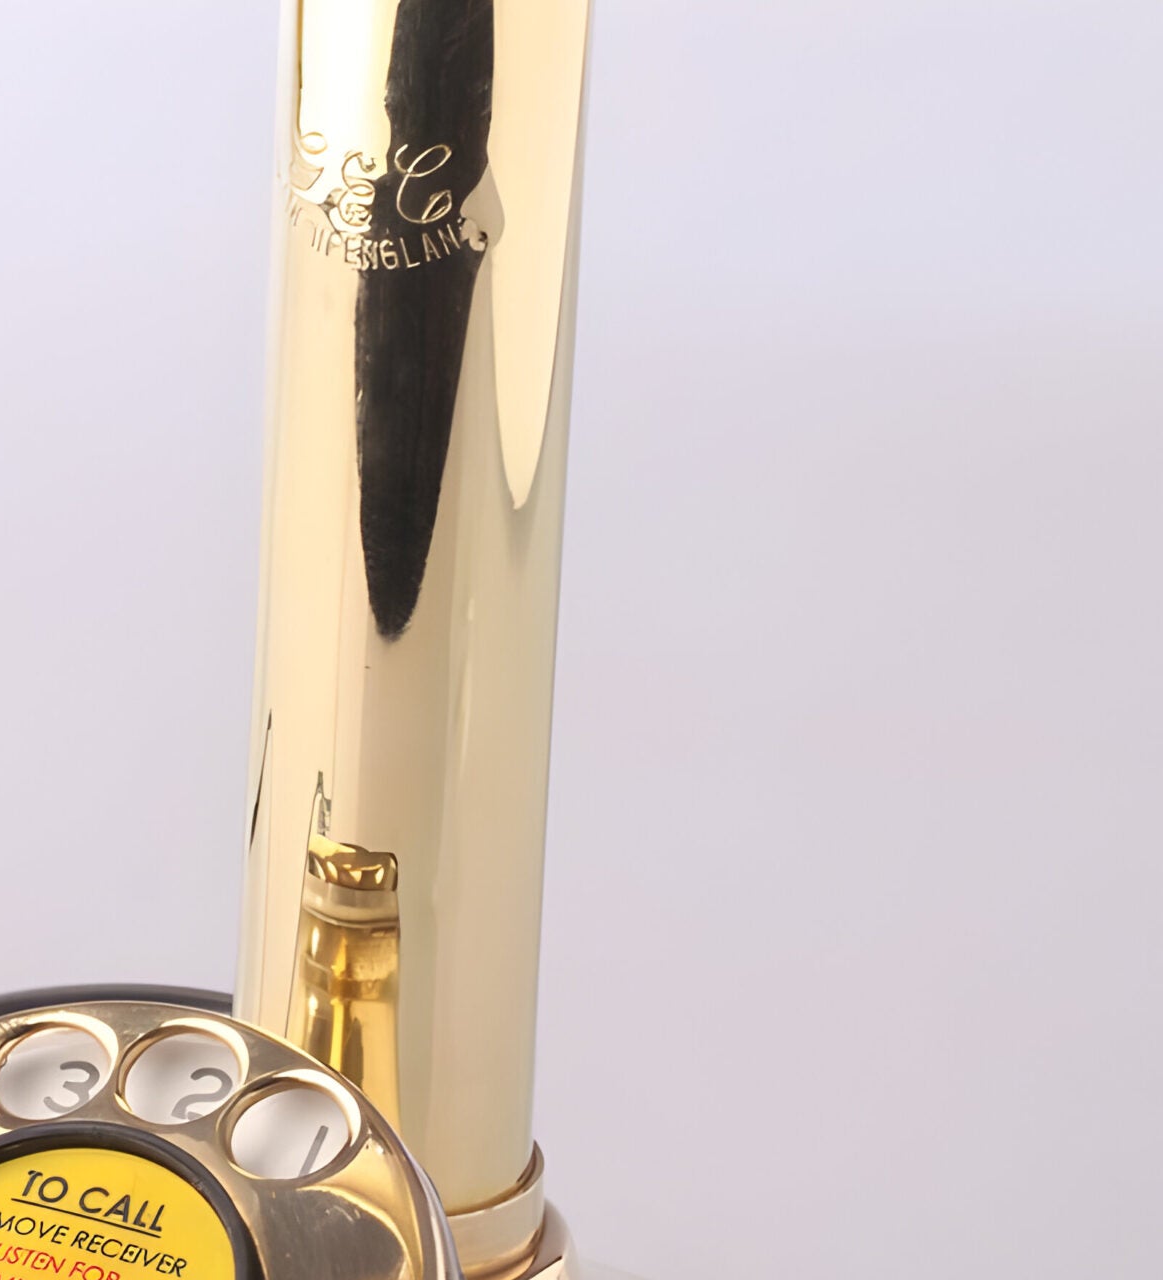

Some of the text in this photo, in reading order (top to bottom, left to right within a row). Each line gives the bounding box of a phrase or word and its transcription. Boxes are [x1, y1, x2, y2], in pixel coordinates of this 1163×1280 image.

[344, 222, 478, 270] ENGLAN
[43, 1060, 100, 1113] 3
[171, 1067, 233, 1120] 2
[21, 1169, 167, 1232] TO CALL
[69, 1230, 188, 1278] RECEIVER
